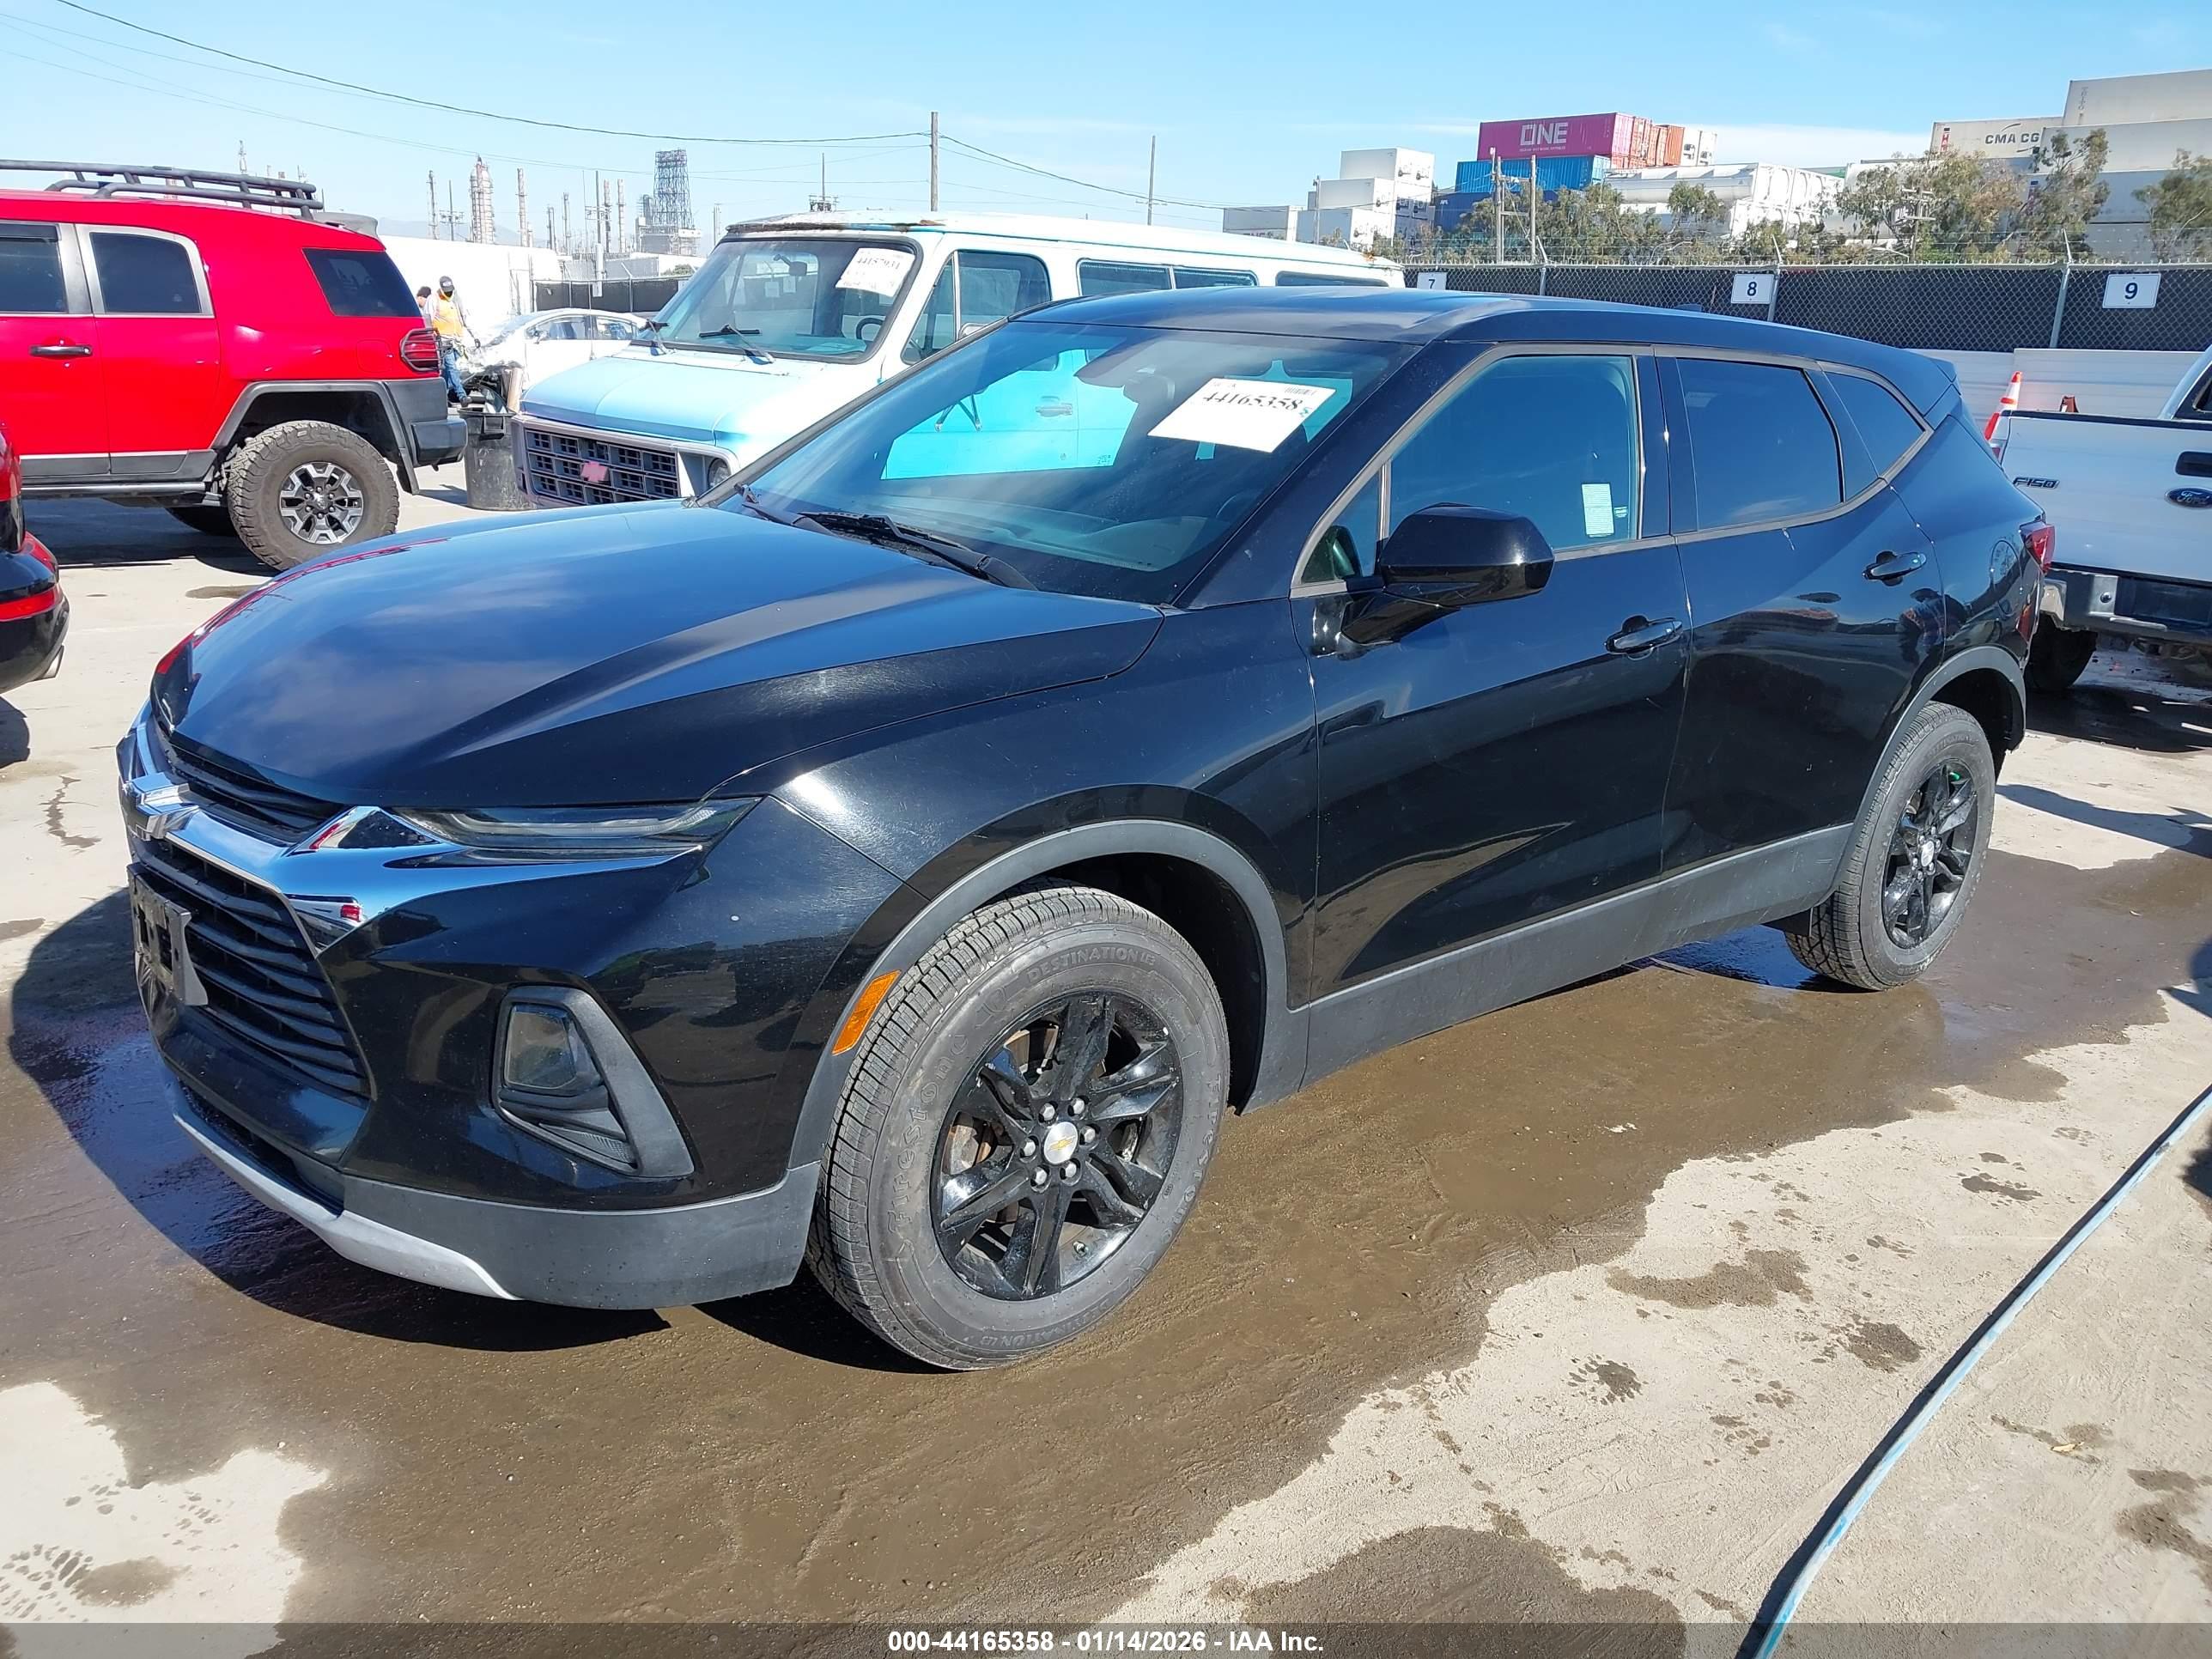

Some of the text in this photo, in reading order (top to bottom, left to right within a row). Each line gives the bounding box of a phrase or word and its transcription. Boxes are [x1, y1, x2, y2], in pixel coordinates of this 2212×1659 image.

[1520, 122, 1568, 145] ONE
[1984, 133, 2016, 144] CMA
[1428, 278, 1436, 289] 7
[1747, 281, 1758, 297] 8
[2124, 282, 2138, 300] 9
[1202, 392, 1304, 411] 44165358
[1026, 946, 1140, 981] DESTINATION
[886, 1033, 969, 1235] Firestone
